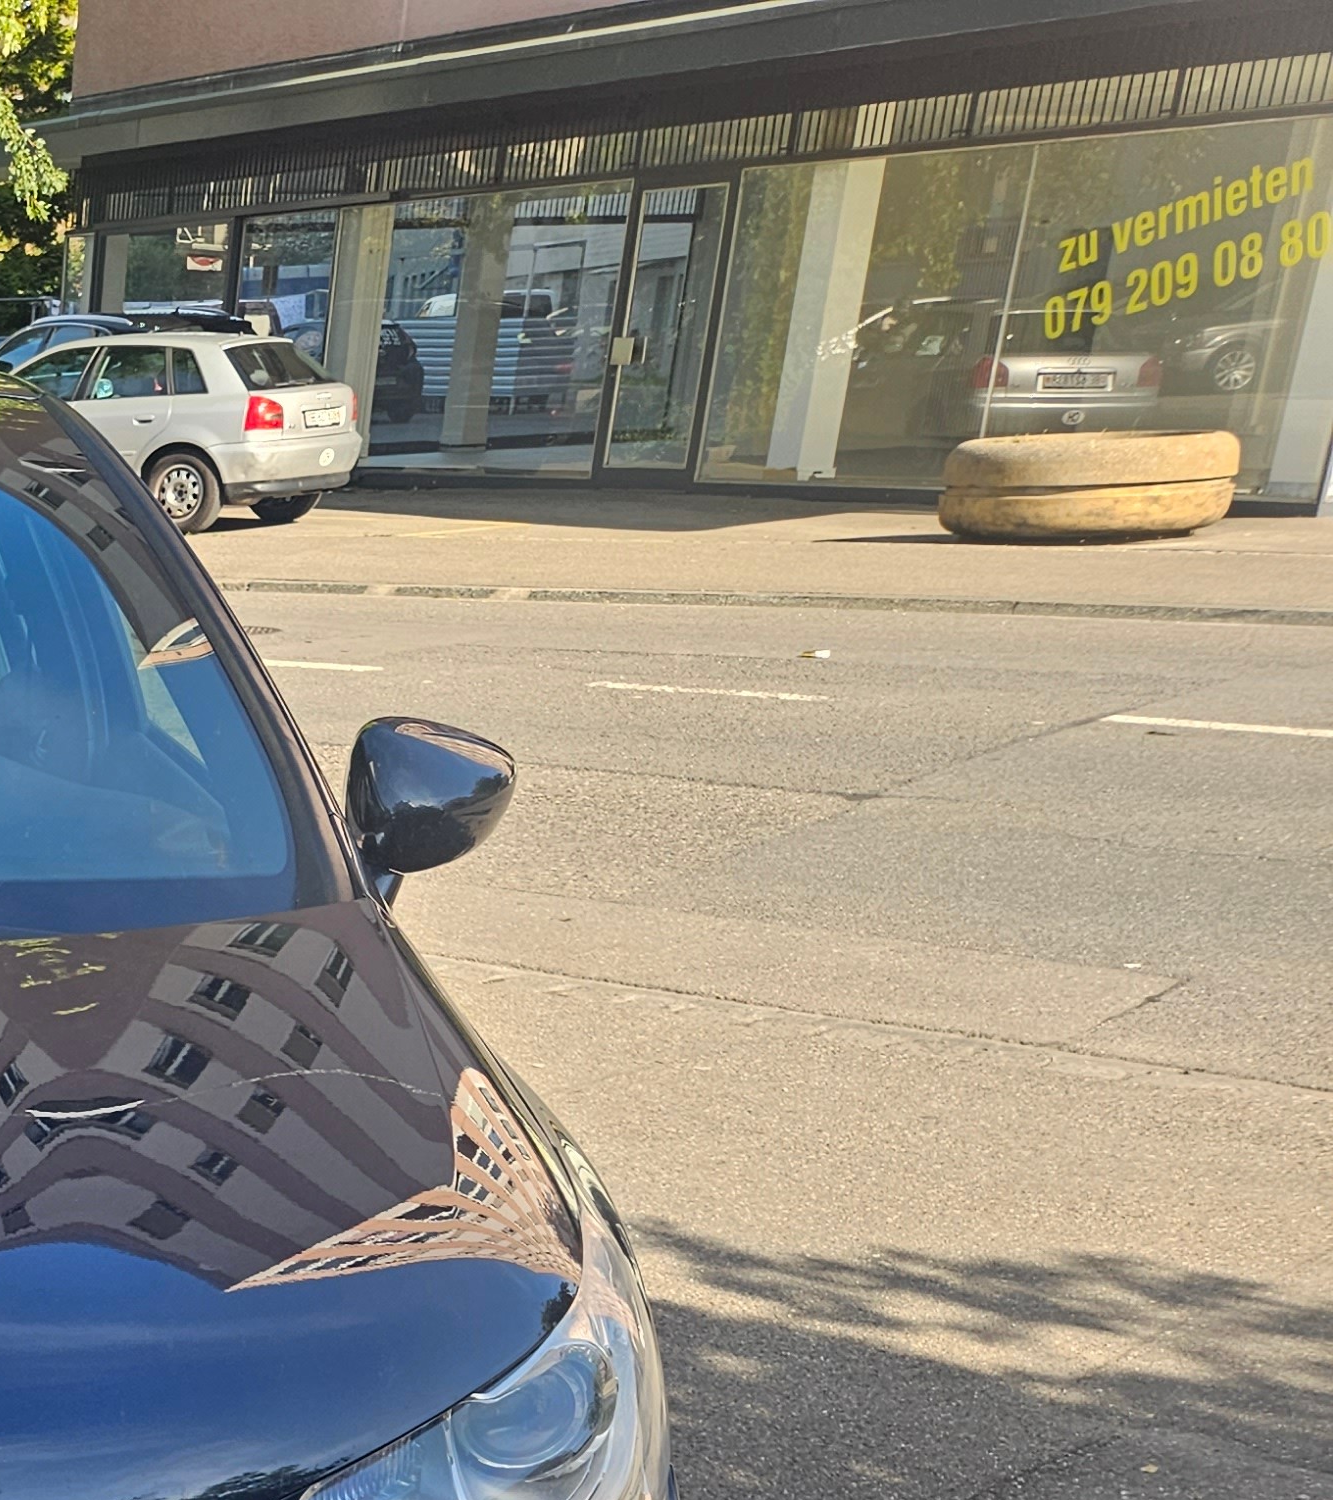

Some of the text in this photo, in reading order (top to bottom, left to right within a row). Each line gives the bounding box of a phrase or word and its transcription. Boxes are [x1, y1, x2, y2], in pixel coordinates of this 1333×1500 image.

[1044, 211, 1332, 340] 079 209 08 80
[1058, 156, 1314, 273] zu vermieten
